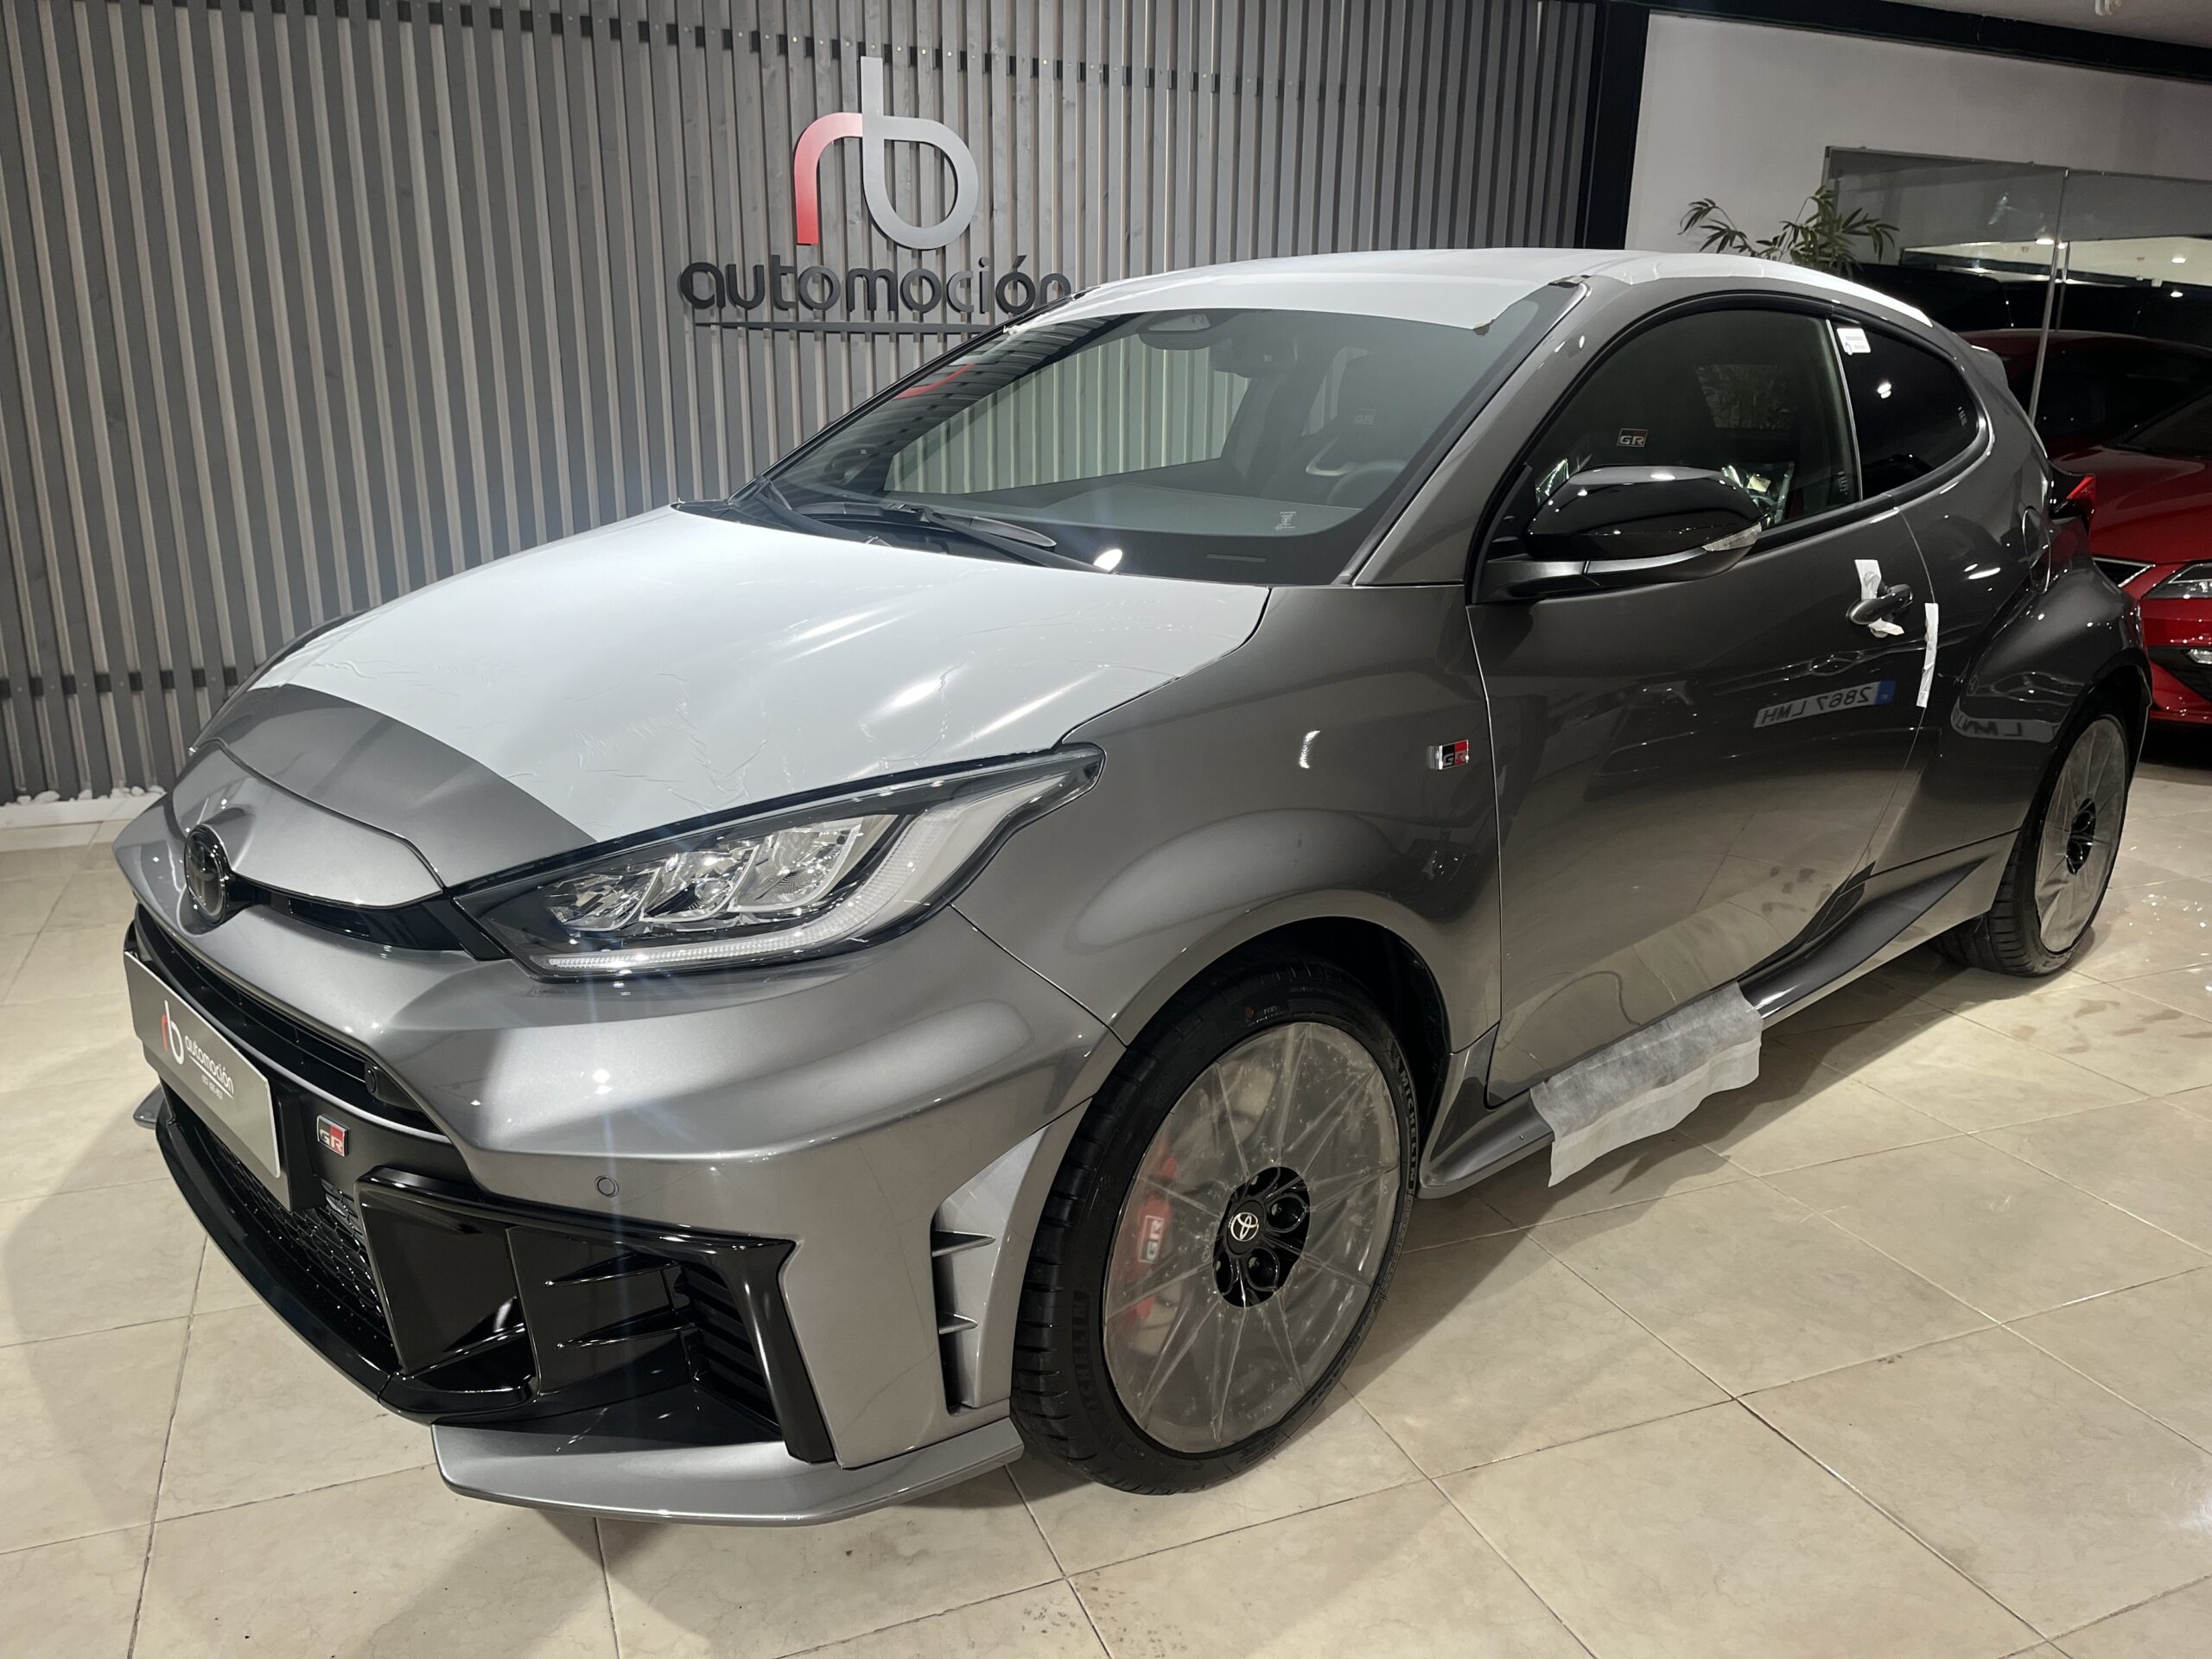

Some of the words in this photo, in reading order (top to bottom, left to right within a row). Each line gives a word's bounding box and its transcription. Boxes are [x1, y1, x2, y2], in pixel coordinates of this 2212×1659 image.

[679, 255, 1071, 315] automoción
[1619, 435, 1645, 446] GR
[1442, 749, 1468, 767] GR
[185, 1035, 234, 1095] automoción
[320, 1128, 344, 1153] GR
[1400, 1069, 1417, 1181] MICHELIN
[1146, 1218, 1163, 1262] GR
